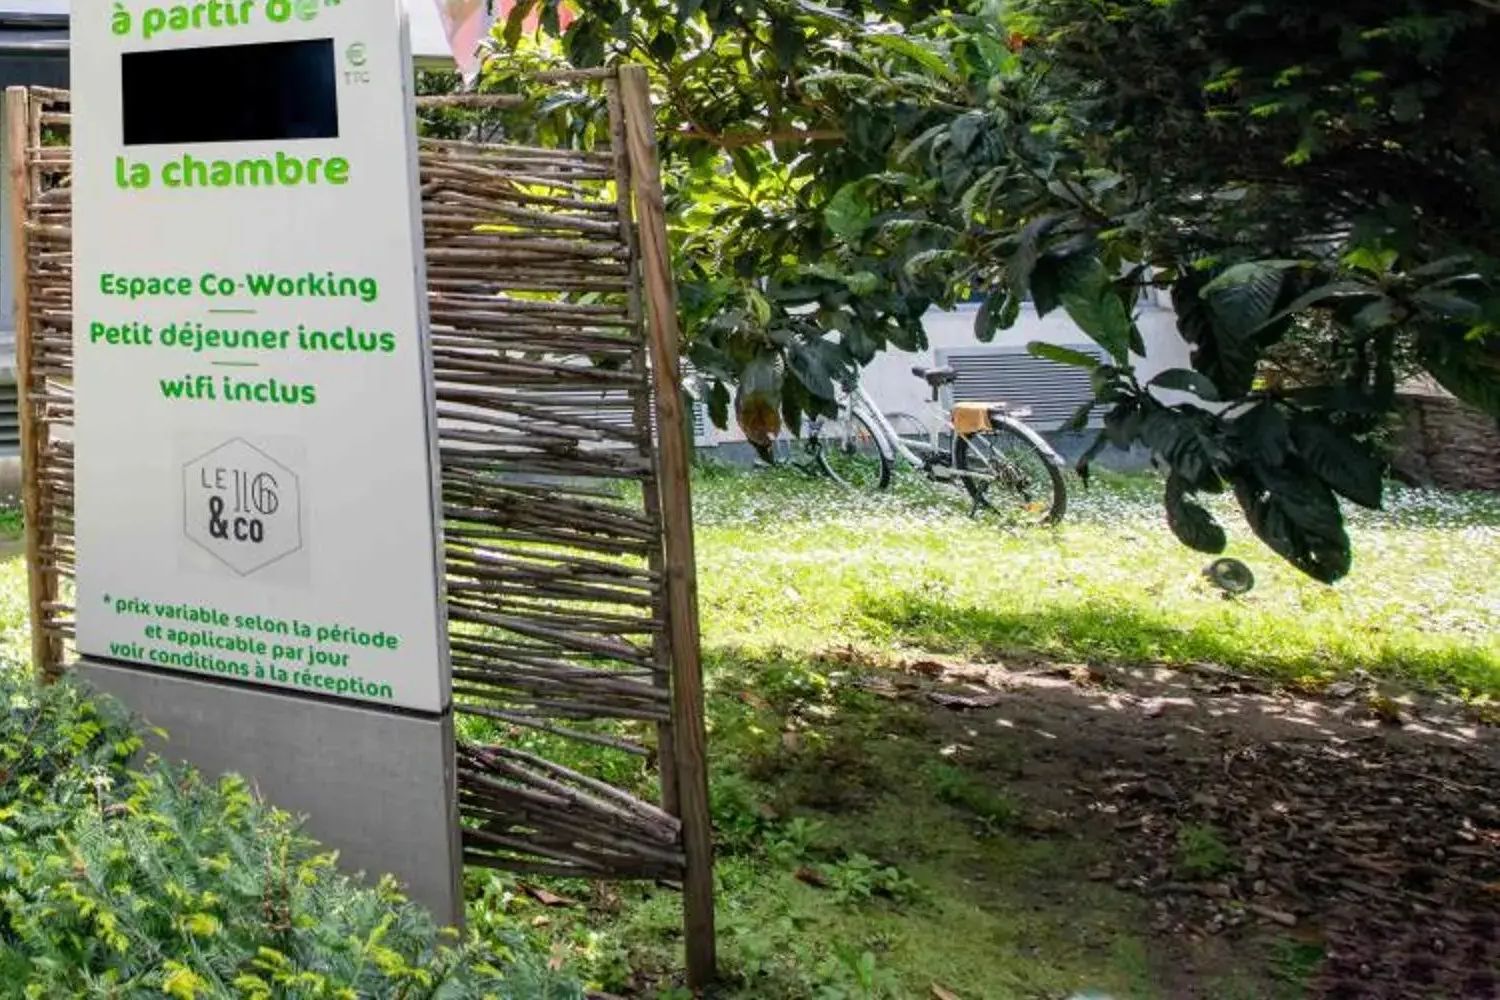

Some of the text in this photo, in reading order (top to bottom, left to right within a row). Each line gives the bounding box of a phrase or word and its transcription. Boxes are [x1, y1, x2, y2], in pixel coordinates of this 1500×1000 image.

[111, 3, 131, 36] à
[344, 41, 368, 67] €
[116, 152, 350, 188] la chambre
[100, 272, 378, 301] Espace Co-Working
[89, 322, 396, 352] Petit déjeuner inclus
[159, 374, 317, 405] wifi inclus
[201, 467, 228, 490] LE
[115, 598, 399, 650] prix variable selon la période
[145, 624, 349, 667] et applicable par jour
[109, 640, 394, 699] voir conditions à la réception
